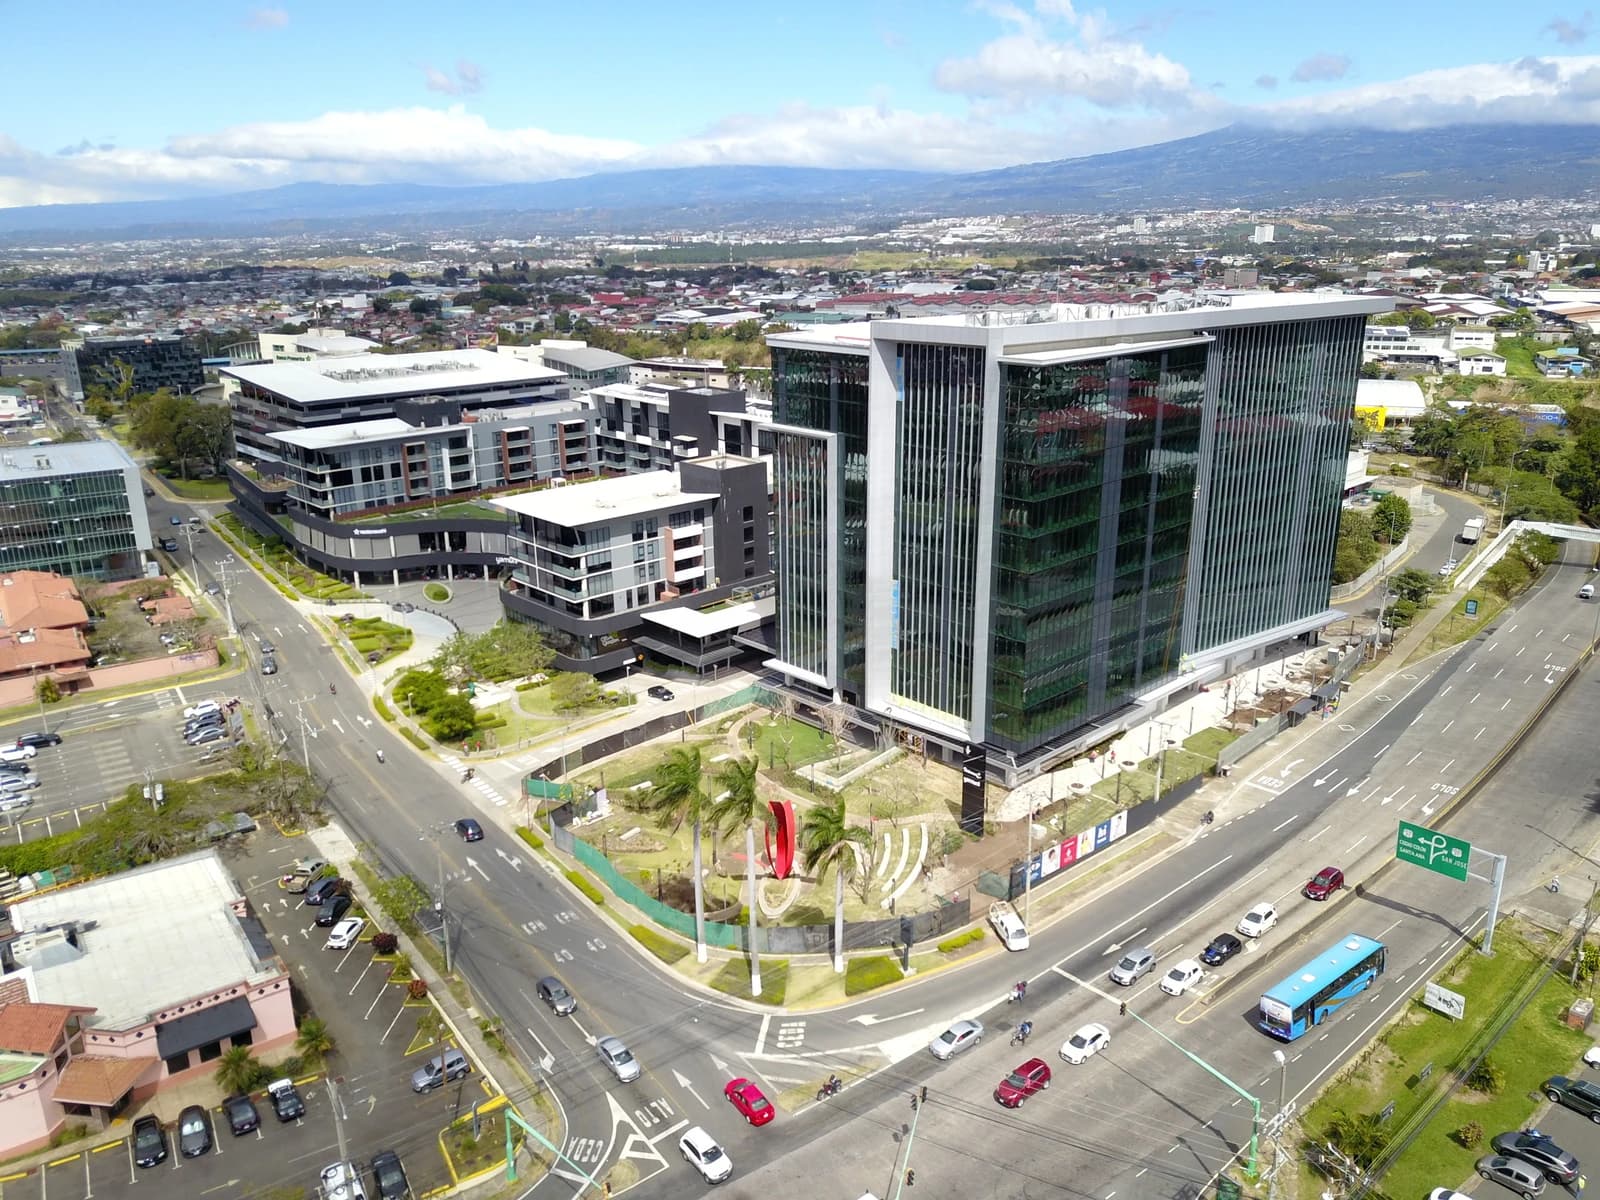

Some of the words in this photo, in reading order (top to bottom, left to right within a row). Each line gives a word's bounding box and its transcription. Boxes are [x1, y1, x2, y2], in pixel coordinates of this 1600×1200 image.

[1430, 782, 1460, 795] SOLO
[1441, 855, 1452, 864] SAN
[554, 949, 574, 963] 40
[635, 1098, 674, 1127] ALTO
[566, 1136, 603, 1163] CEDA
